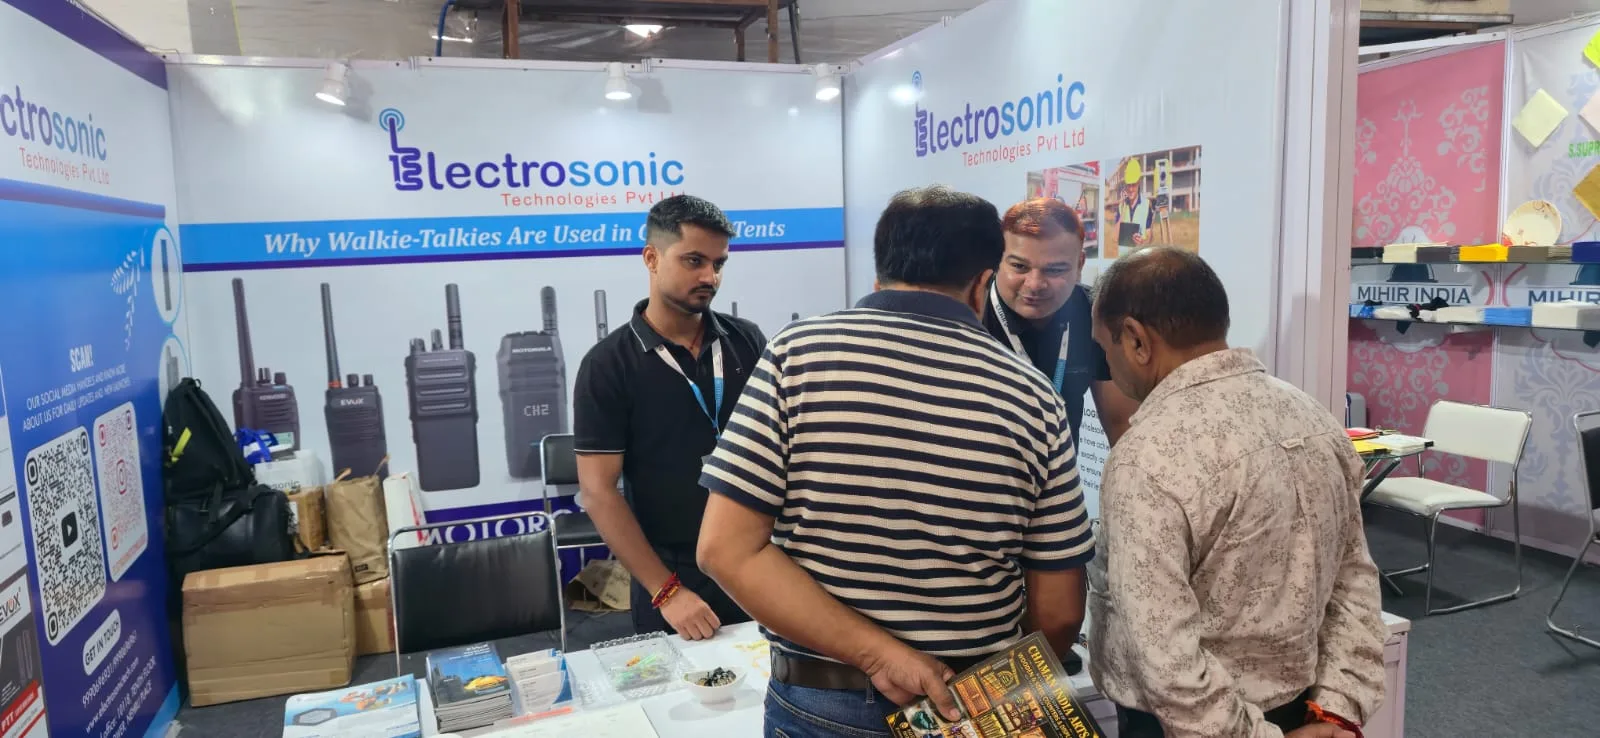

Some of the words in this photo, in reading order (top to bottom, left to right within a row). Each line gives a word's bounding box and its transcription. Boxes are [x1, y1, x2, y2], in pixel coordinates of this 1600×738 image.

[914, 73, 1085, 157] Electrosonic
[388, 130, 685, 191] Electrosonic
[962, 142, 1032, 168] Technologies
[1037, 135, 1058, 153] Pvt
[1063, 127, 1085, 150] Ltd
[19, 146, 80, 181] Technologies
[82, 163, 97, 183] Pvt
[501, 191, 617, 209] Technologies
[626, 191, 653, 205] Pvt
[263, 231, 321, 259] Why
[327, 226, 502, 252] Walkie-Talkies
[506, 226, 548, 247] Are
[553, 224, 608, 245] Used
[612, 223, 634, 242] in
[733, 220, 786, 239] Tents
[1357, 285, 1409, 303] MIHIR
[1415, 286, 1471, 304] INDIA
[1528, 290, 1600, 306] MIHIR
[69, 344, 94, 373] SCAN!
[26, 397, 40, 411] OUR
[40, 389, 61, 406] SOCIAL
[523, 404, 549, 417] CH2
[23, 412, 43, 432] ABOUT
[52, 405, 64, 420] FOR
[85, 646, 96, 666] GET
[96, 637, 104, 651] IN
[103, 620, 119, 641] TOUCH
[1028, 645, 1057, 688] CHAMAN
[1054, 688, 1075, 717] INDIA
[1068, 716, 1091, 738] ARTS
